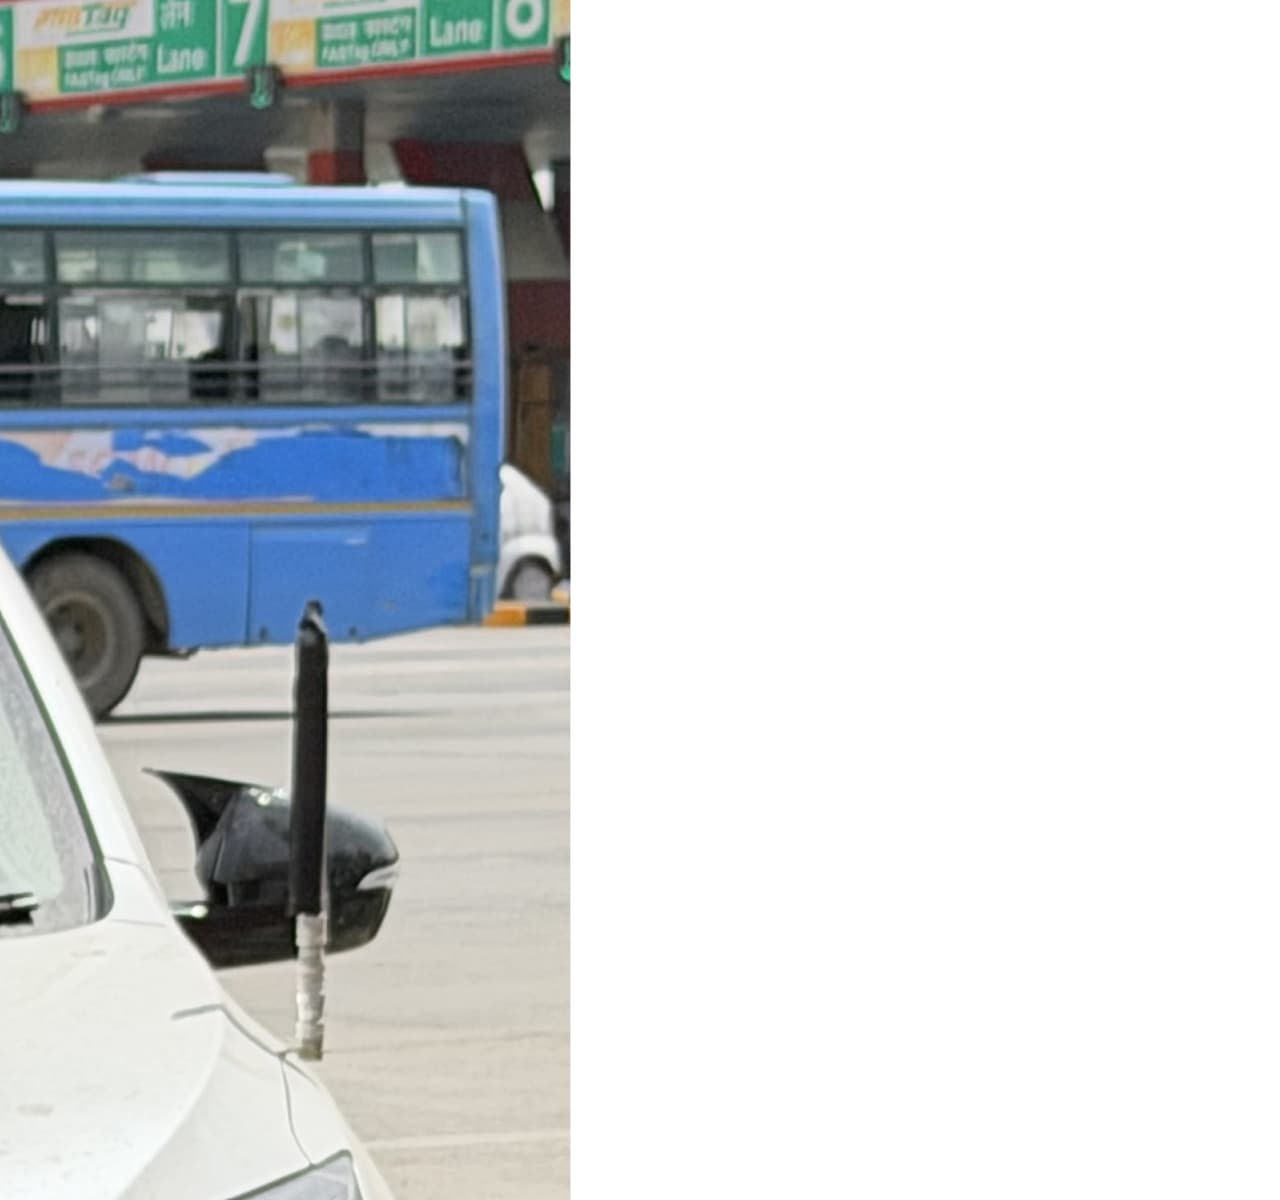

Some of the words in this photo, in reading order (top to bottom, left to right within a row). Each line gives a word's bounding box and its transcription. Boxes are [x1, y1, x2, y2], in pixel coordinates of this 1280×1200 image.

[229, 0, 261, 66] 7
[430, 18, 483, 47] Lane
[157, 43, 207, 74] Lane
